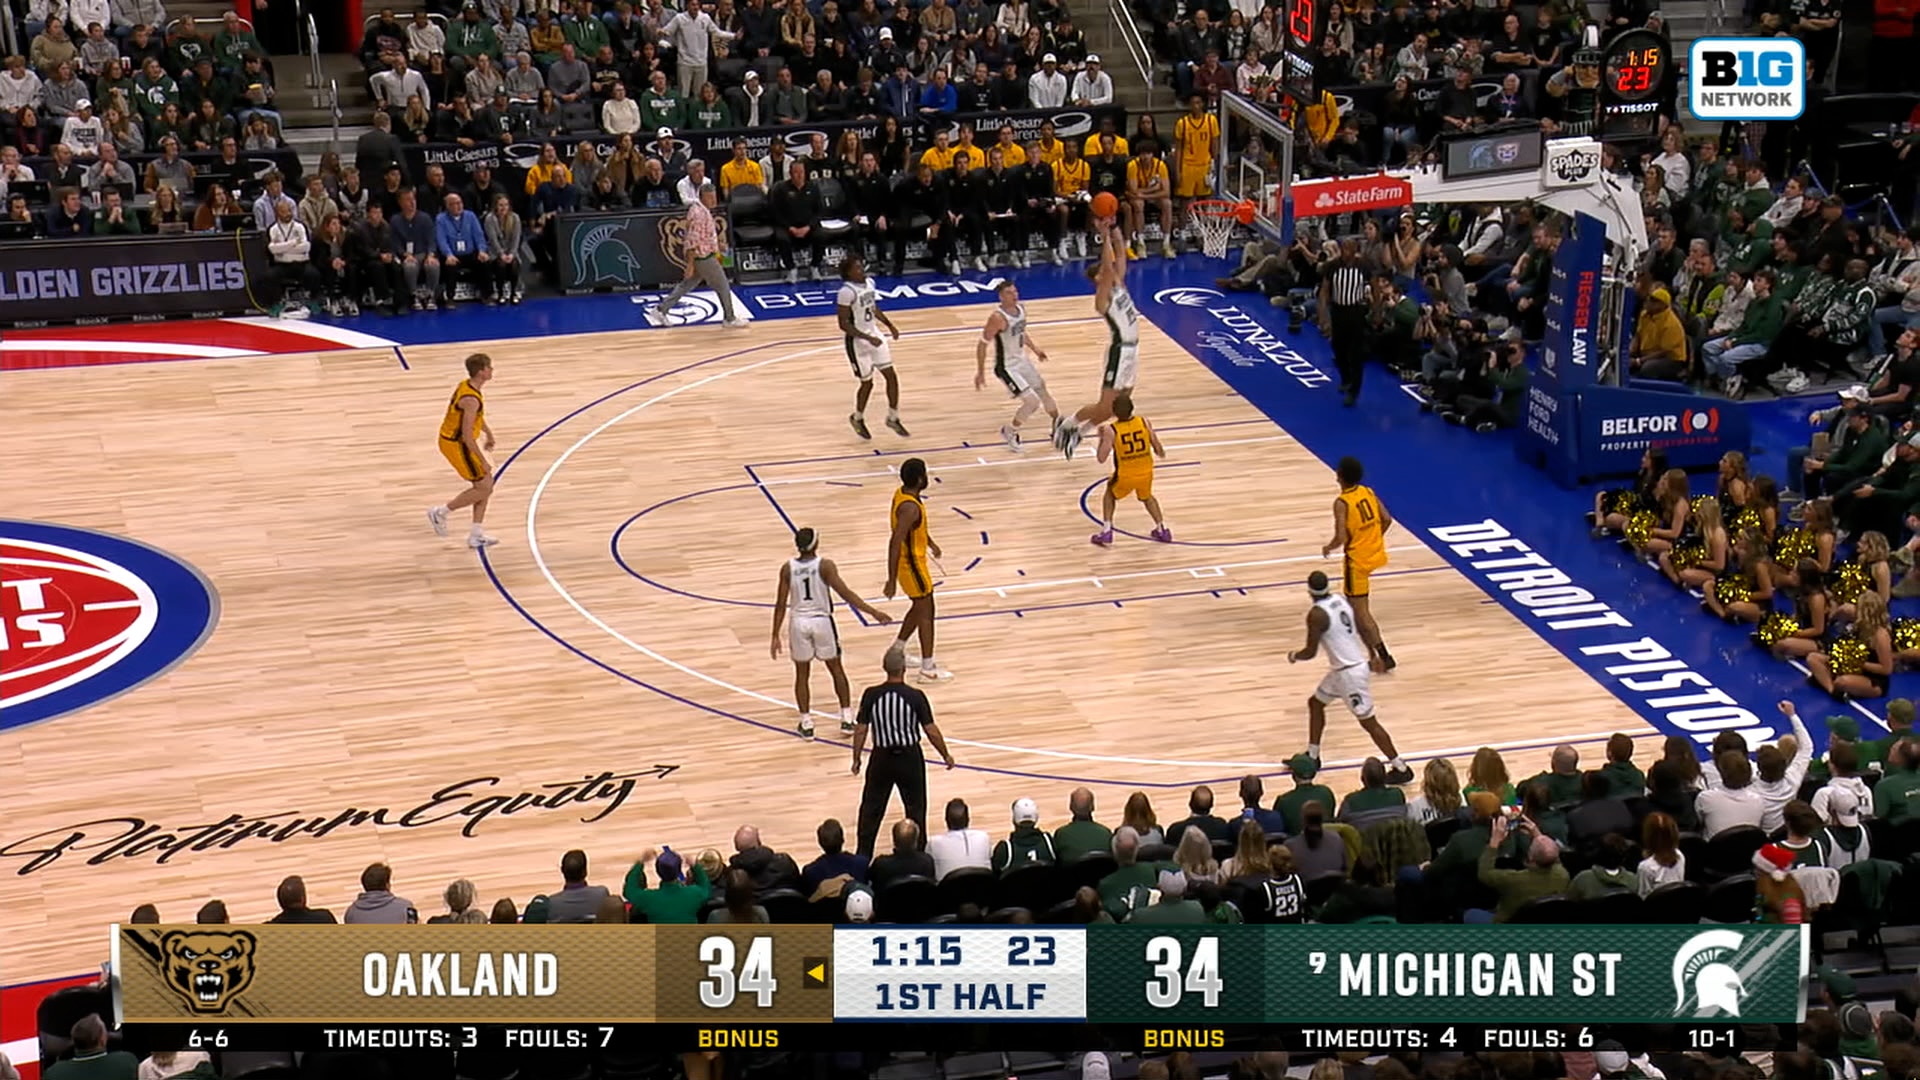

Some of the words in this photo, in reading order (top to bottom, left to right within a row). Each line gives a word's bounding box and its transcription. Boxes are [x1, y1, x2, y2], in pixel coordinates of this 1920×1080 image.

[1629, 48, 1659, 66] 1:15
[1617, 67, 1651, 92] 23
[1620, 102, 1659, 114] TISSOT
[423, 150, 454, 164] Little
[455, 148, 498, 162] Caesars
[707, 136, 734, 151] Littl
[1551, 153, 1600, 173] SPADES
[91, 260, 246, 297] GRIZZLIES
[1573, 271, 1595, 328] FIEGER
[1206, 305, 1331, 388] LUNAZUL
[1572, 328, 1588, 366] LAW
[1530, 385, 1558, 413] HENRY
[1529, 401, 1551, 423] FORD
[1527, 416, 1560, 445] HEALTH
[1601, 415, 1678, 437] BELFOR
[1121, 430, 1146, 456] 55
[1601, 440, 1651, 451] PROPERTY
[1355, 498, 1375, 524] 10
[1427, 517, 1633, 631] DETROIT
[802, 576, 813, 601] 1
[1340, 610, 1353, 634] 9
[0, 817, 400, 876] Platinum
[400, 770, 640, 838] Equity
[1275, 893, 1299, 917] 23
